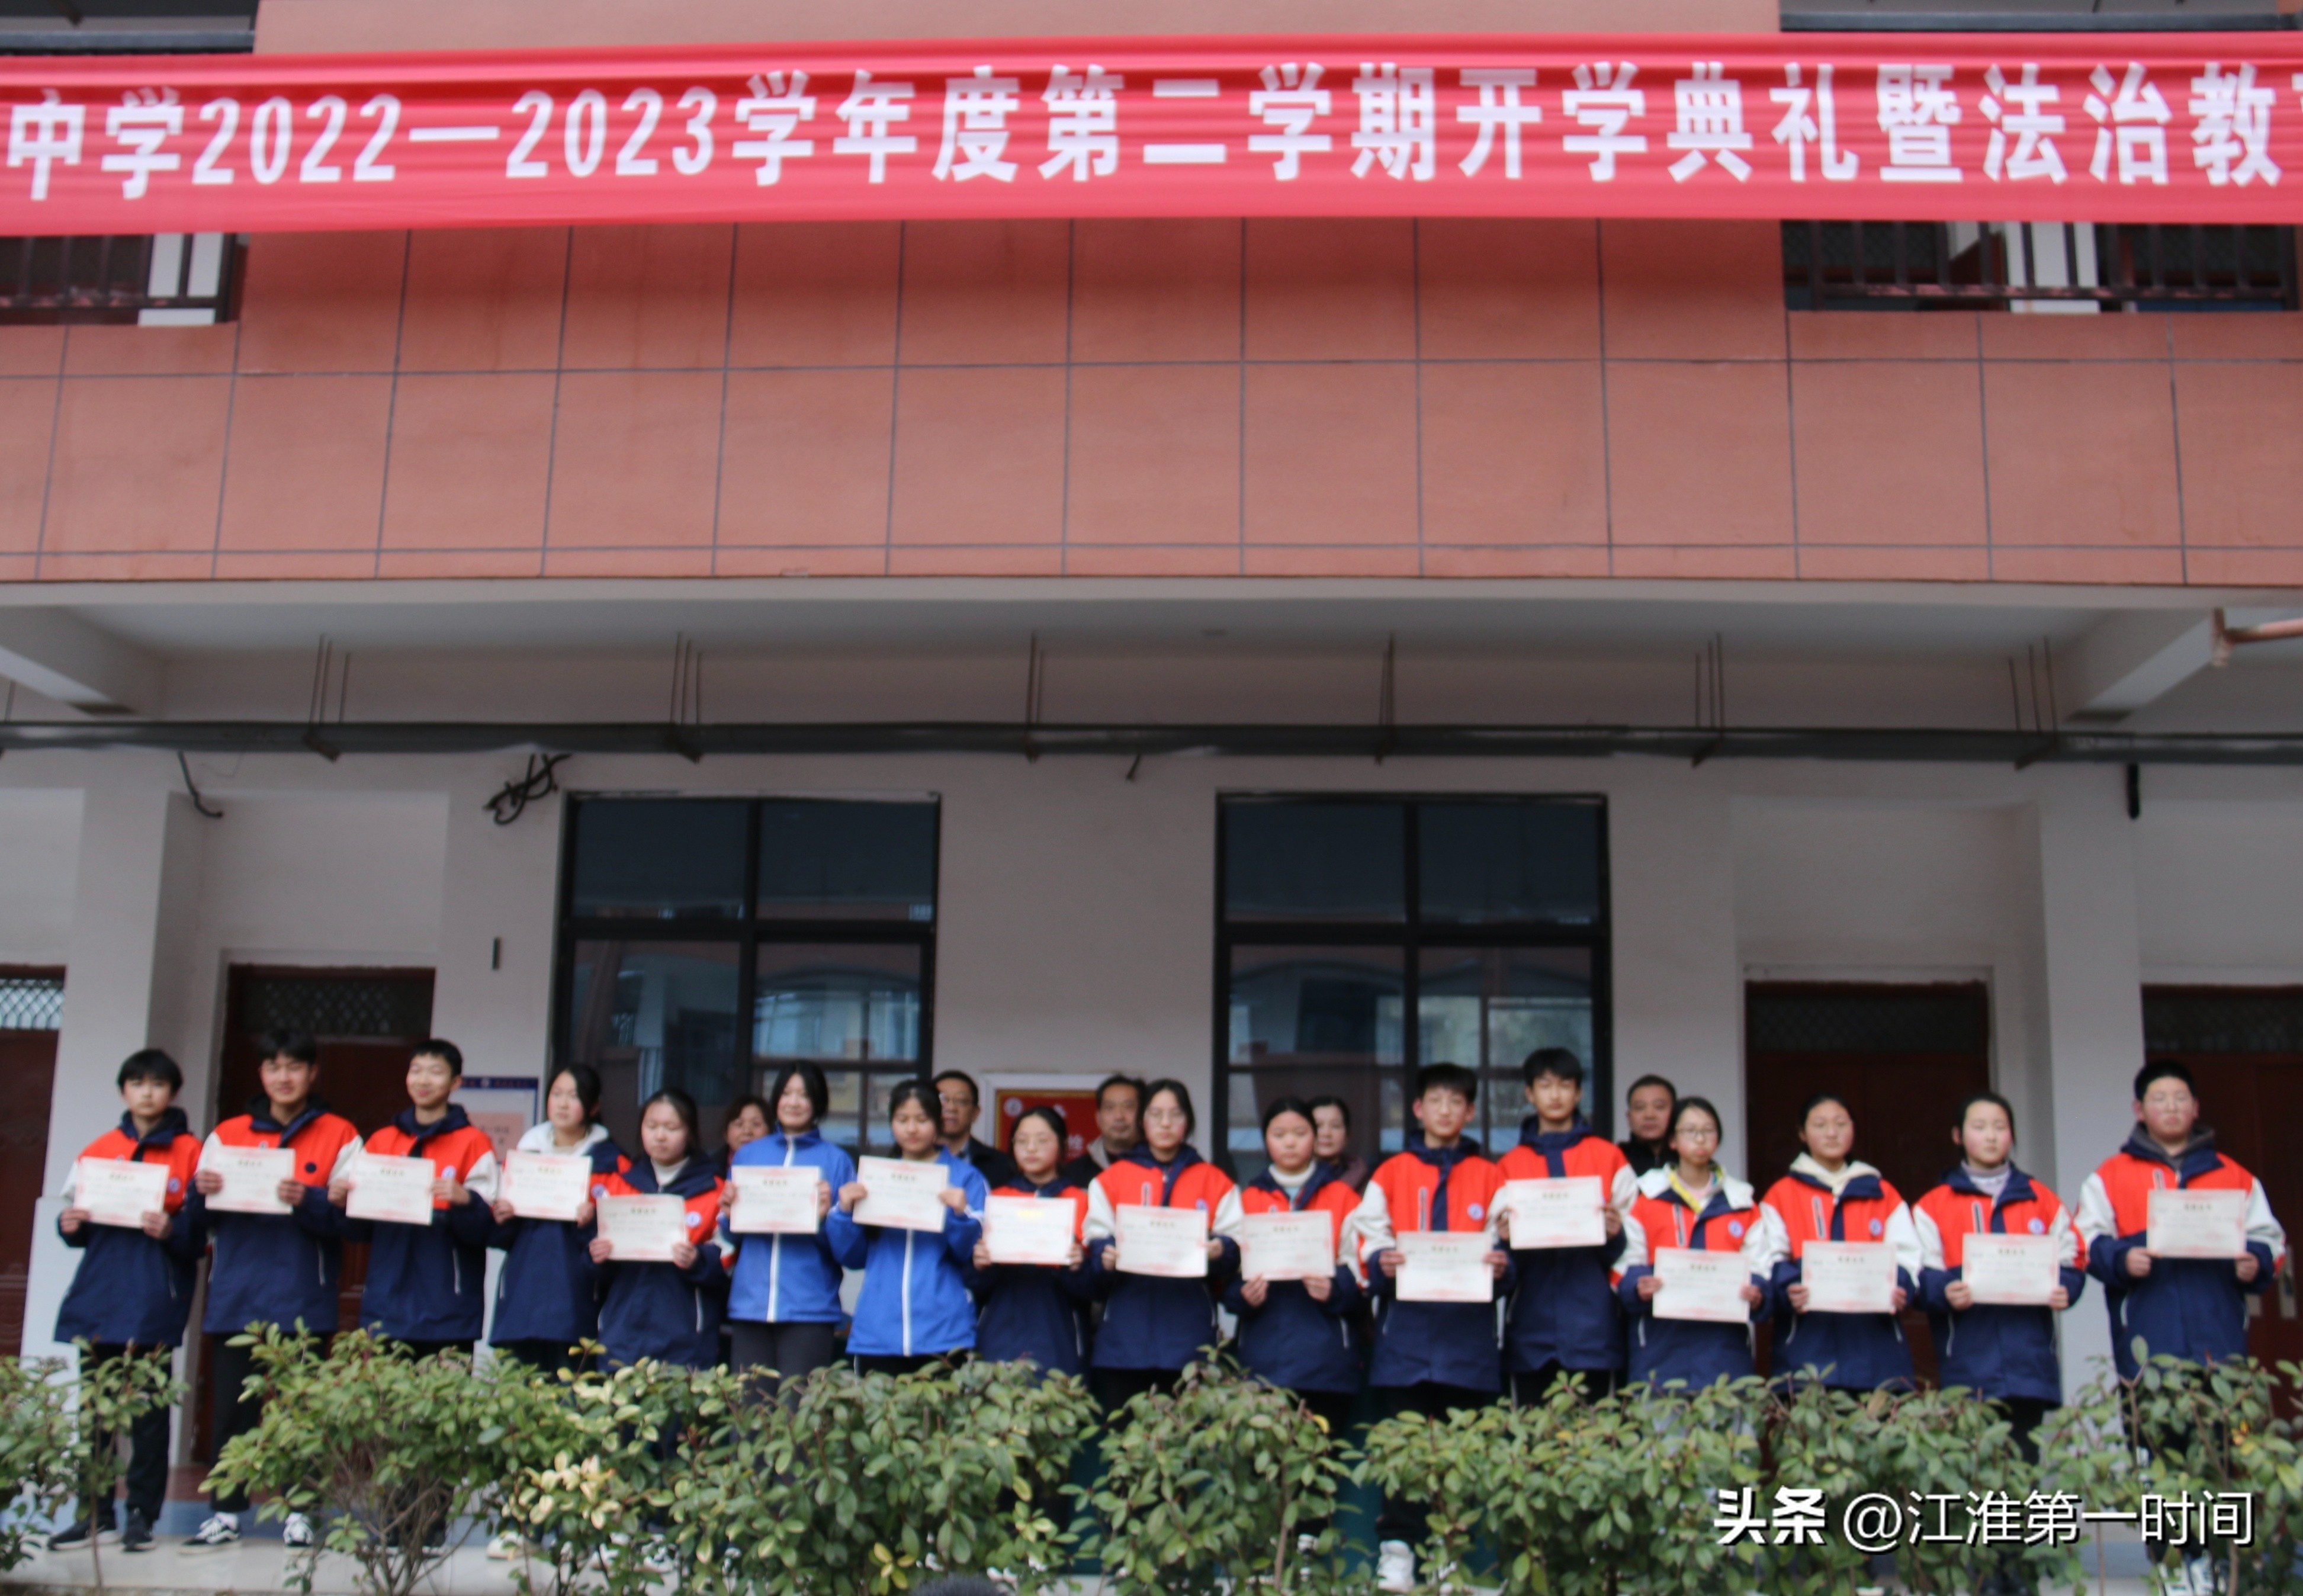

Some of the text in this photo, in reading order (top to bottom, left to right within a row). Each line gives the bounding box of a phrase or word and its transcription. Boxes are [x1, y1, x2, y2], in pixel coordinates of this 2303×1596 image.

[7, 61, 2303, 201] 中学2022—2023学年度第二学期开学典礼暨法治教
